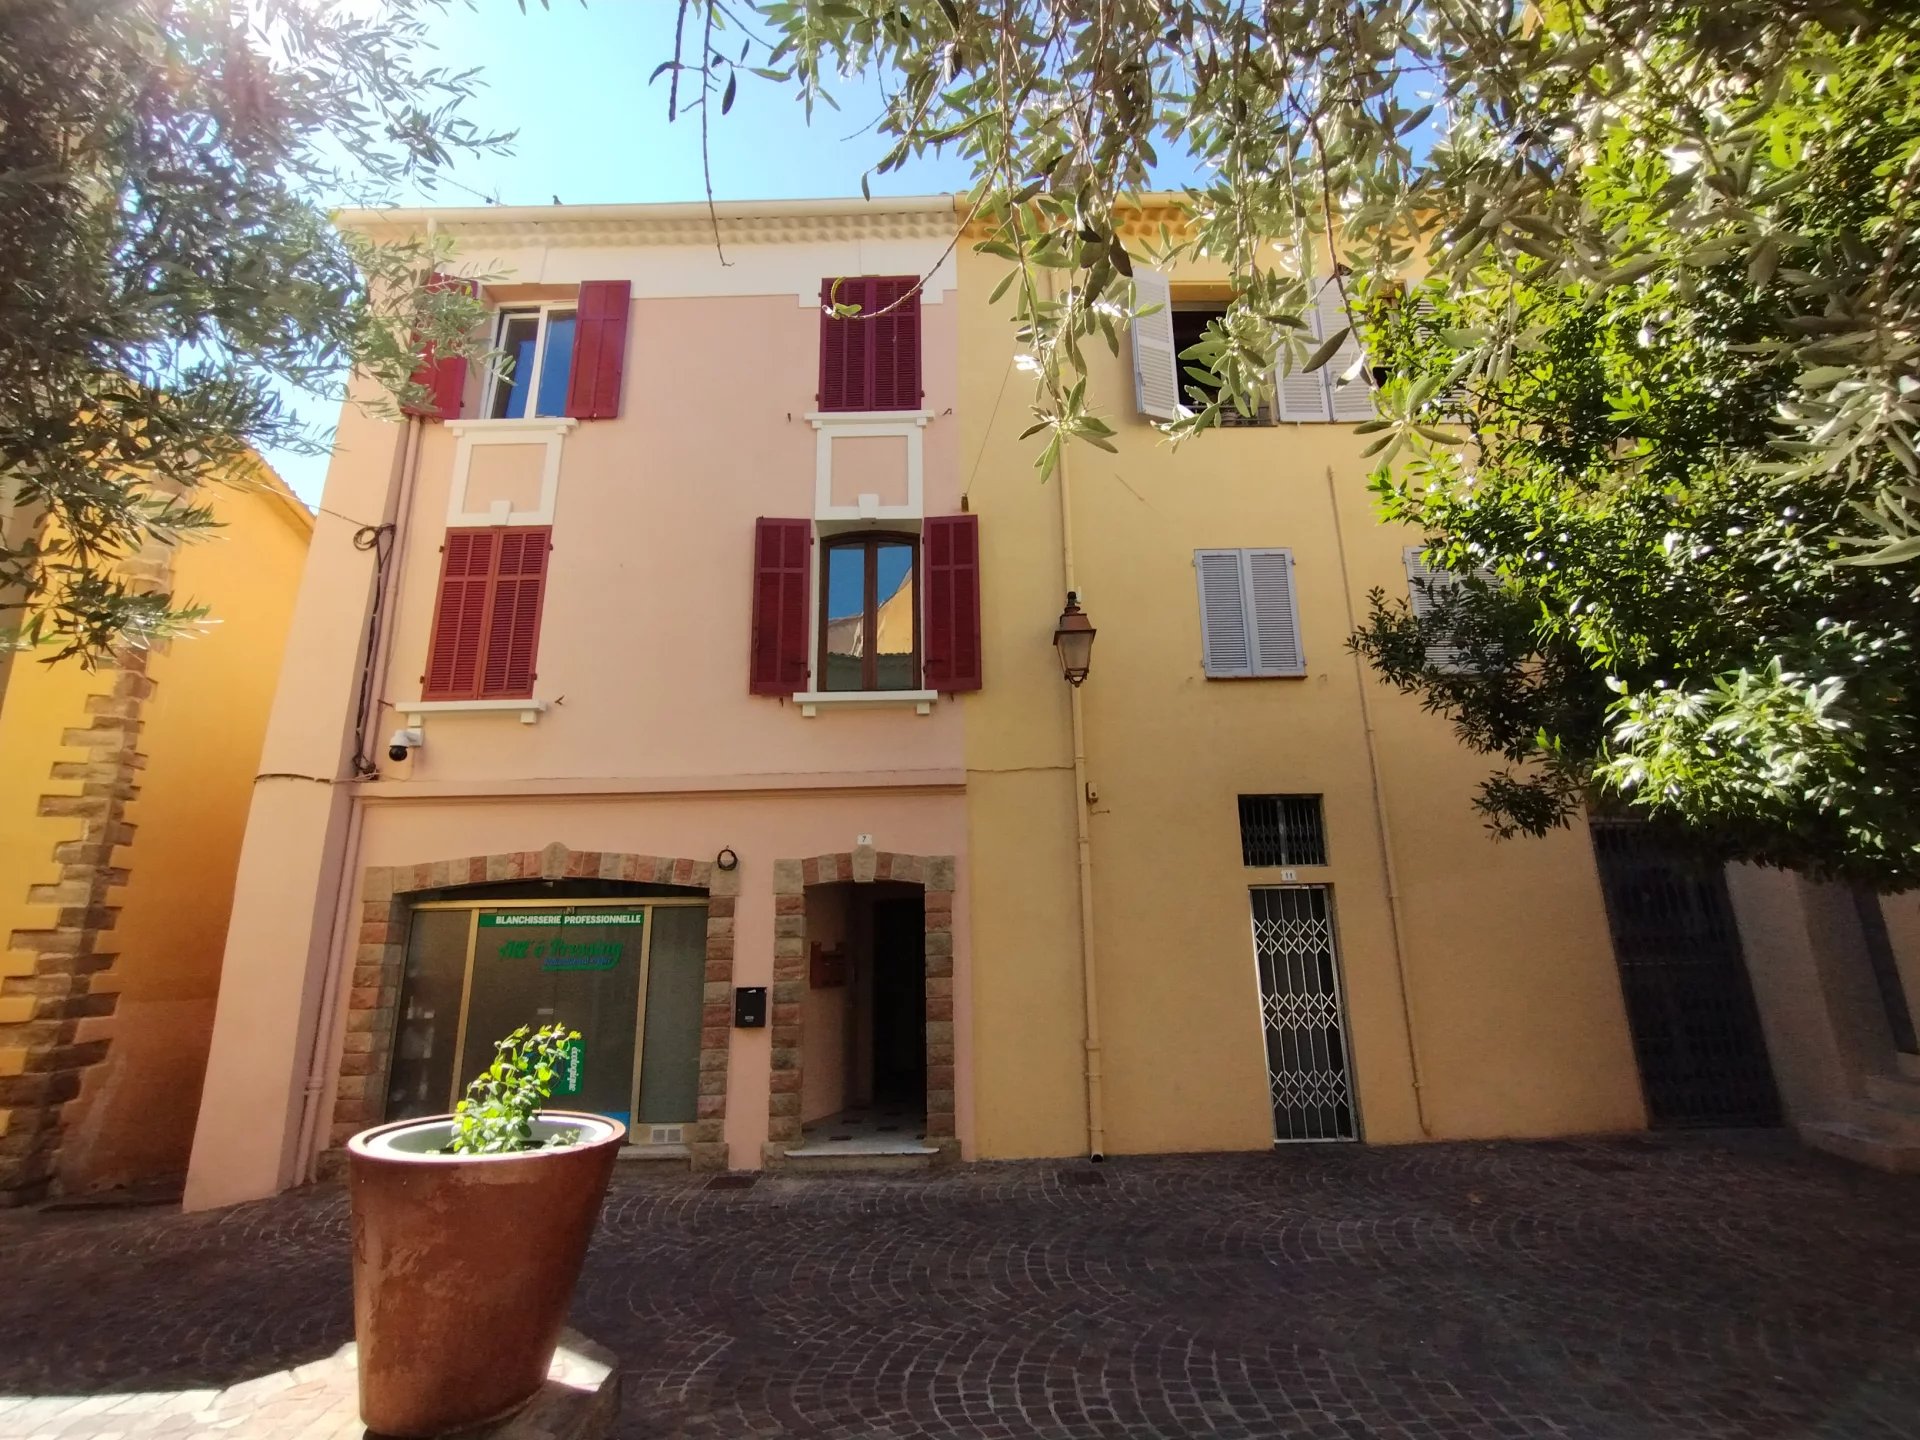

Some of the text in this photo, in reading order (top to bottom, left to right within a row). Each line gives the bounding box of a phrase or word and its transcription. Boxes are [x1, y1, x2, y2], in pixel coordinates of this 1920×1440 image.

[495, 914, 641, 925] BLANCHISSERIE PROFESSIONNELLE
[567, 1046, 581, 1092] écologique
